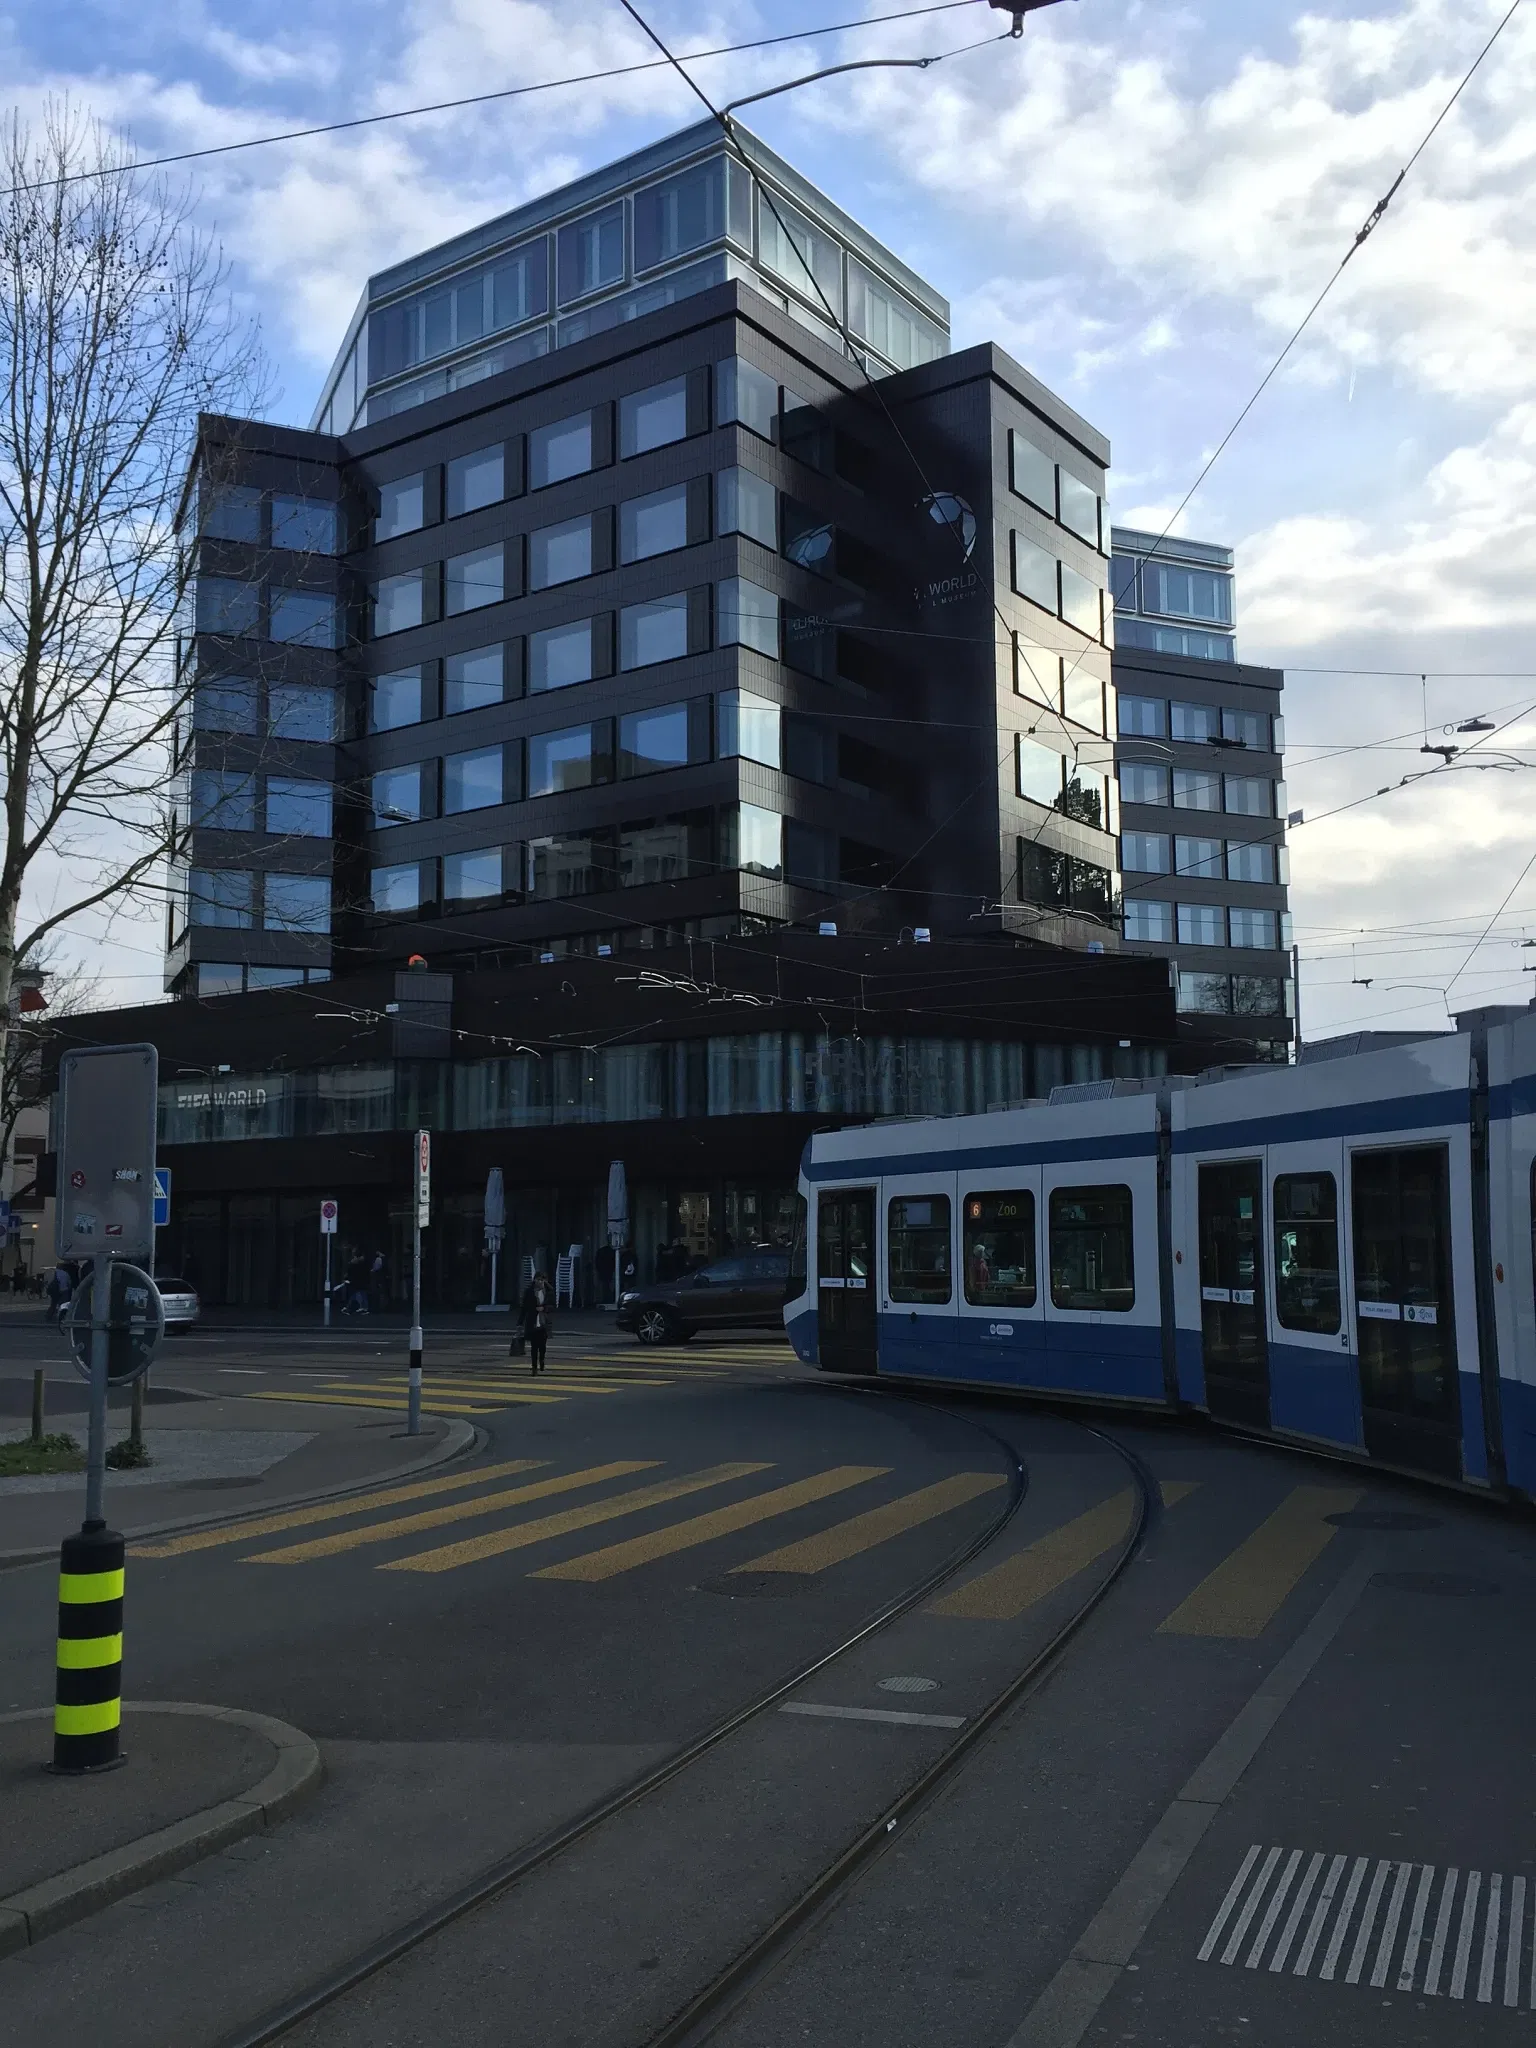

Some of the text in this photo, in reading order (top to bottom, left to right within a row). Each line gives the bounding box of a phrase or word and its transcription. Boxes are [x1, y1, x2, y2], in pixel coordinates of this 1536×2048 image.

[928, 572, 977, 596] WORLD
[177, 1088, 266, 1109] FIFA WORLD
[973, 1200, 1017, 1216] 6 Zoo
